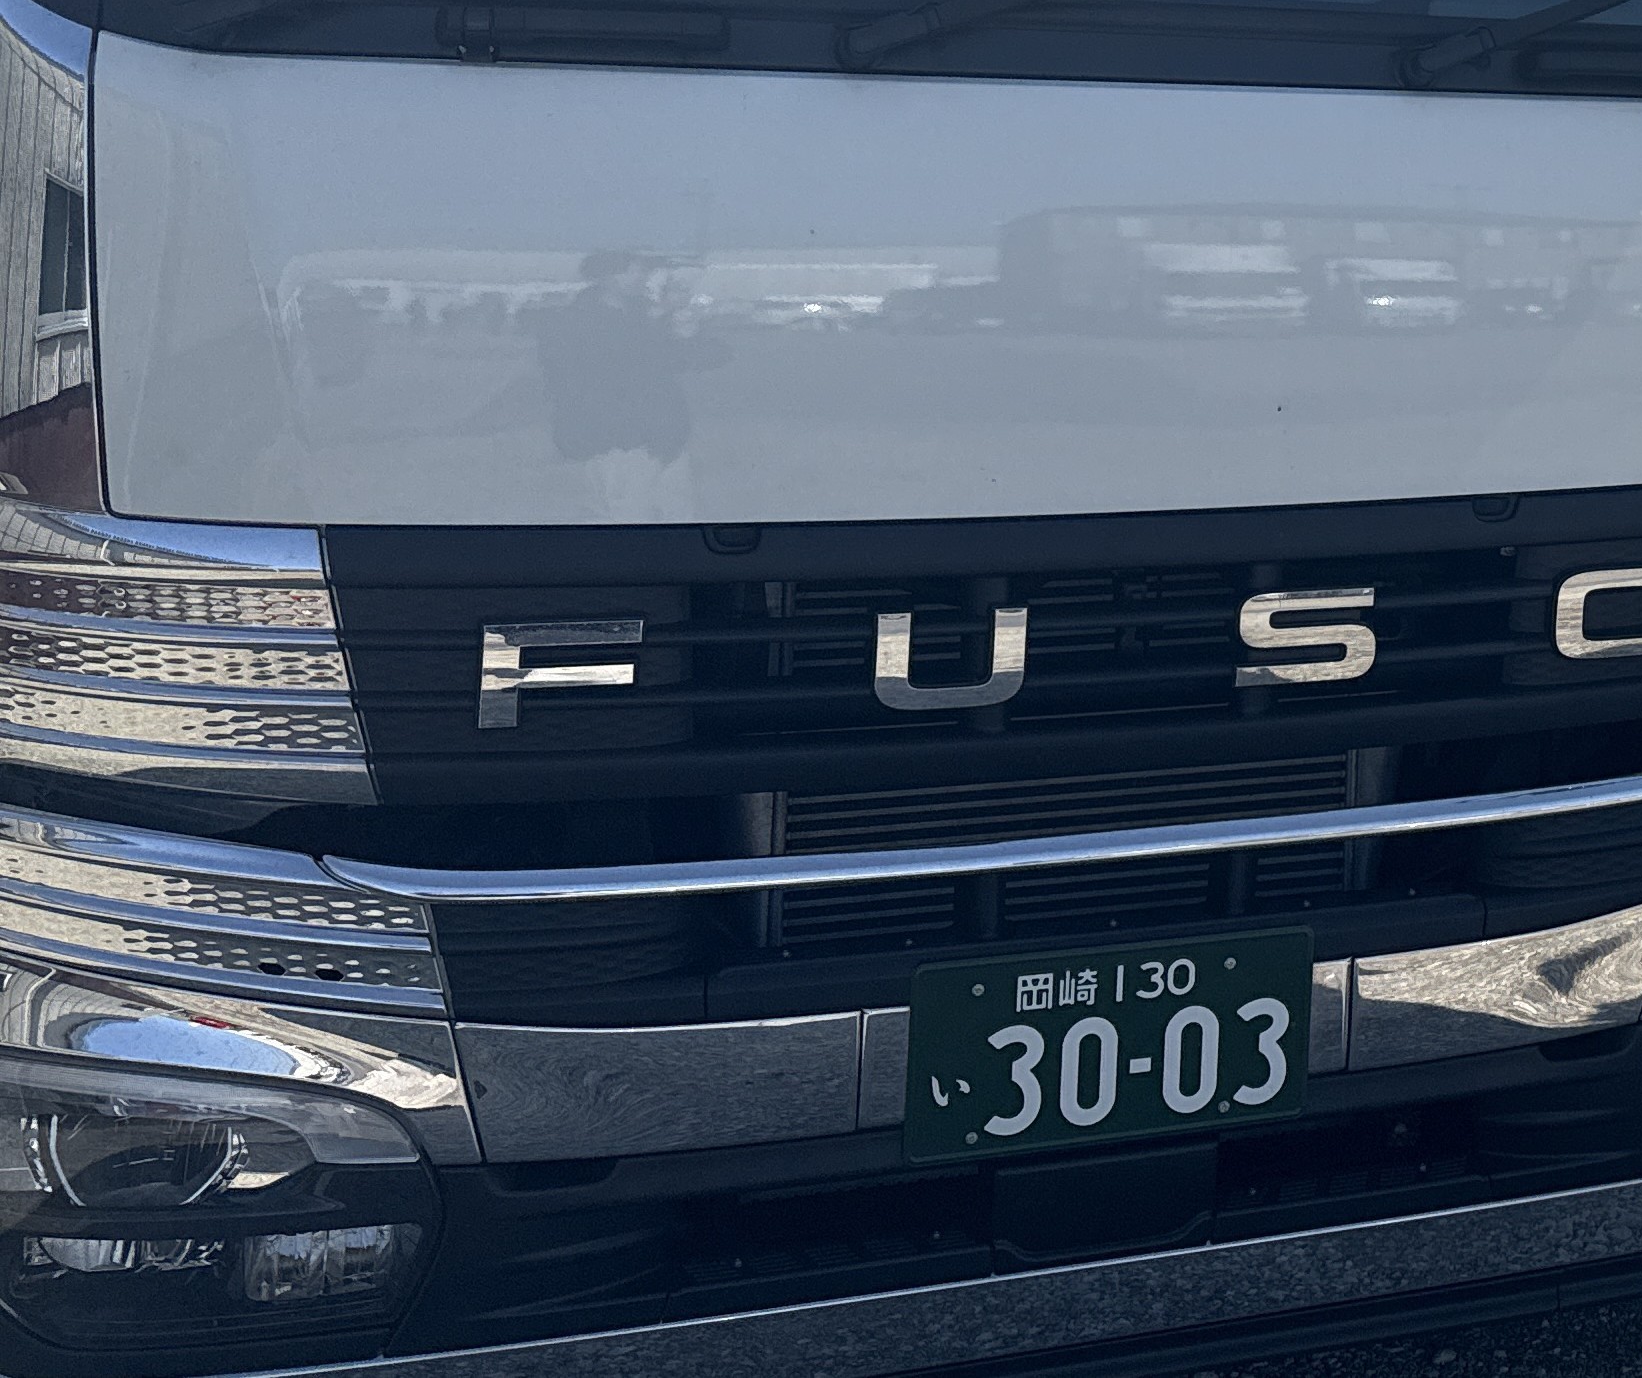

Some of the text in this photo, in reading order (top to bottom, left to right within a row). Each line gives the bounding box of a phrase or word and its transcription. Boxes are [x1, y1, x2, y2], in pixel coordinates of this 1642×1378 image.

[1016, 957, 1197, 1013] 岡崎 130
[931, 996, 1291, 1137] い 30-03
